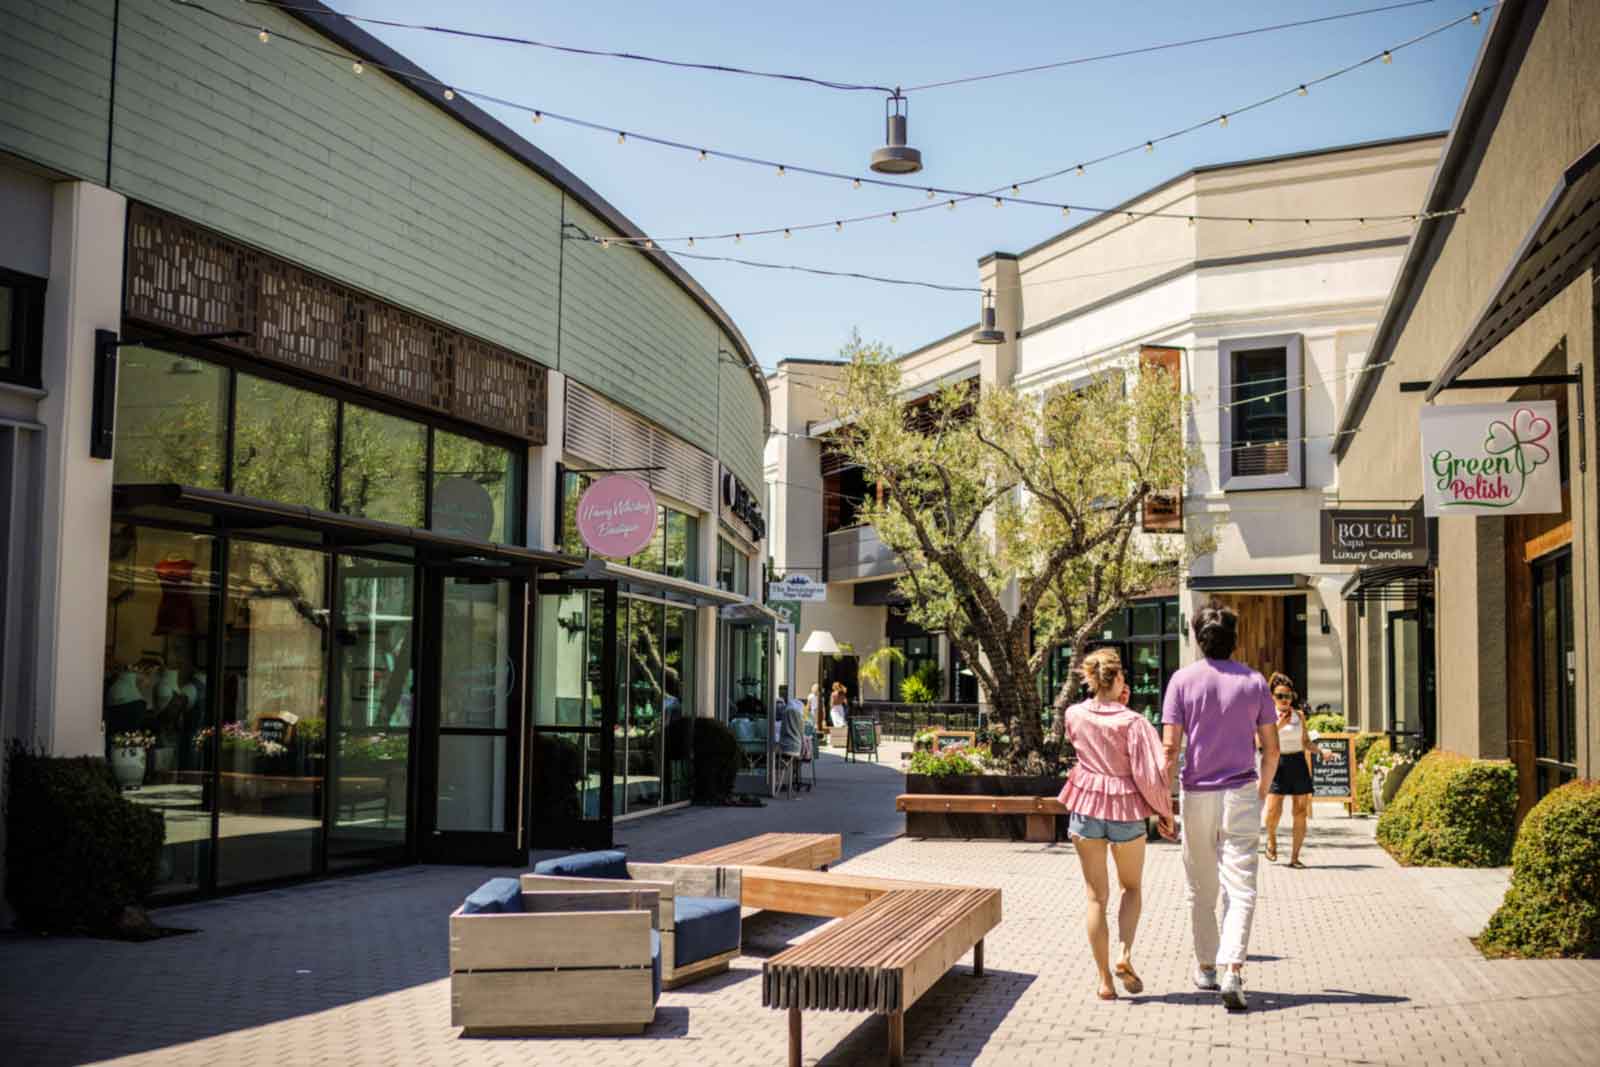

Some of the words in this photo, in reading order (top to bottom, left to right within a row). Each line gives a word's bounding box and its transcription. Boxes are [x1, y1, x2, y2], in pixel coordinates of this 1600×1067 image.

[1430, 450, 1514, 491] Green
[1449, 474, 1512, 499] Polish
[1338, 523, 1409, 538] BOUGIE
[1332, 549, 1367, 562] Luxury
[1368, 549, 1414, 561] Candles
